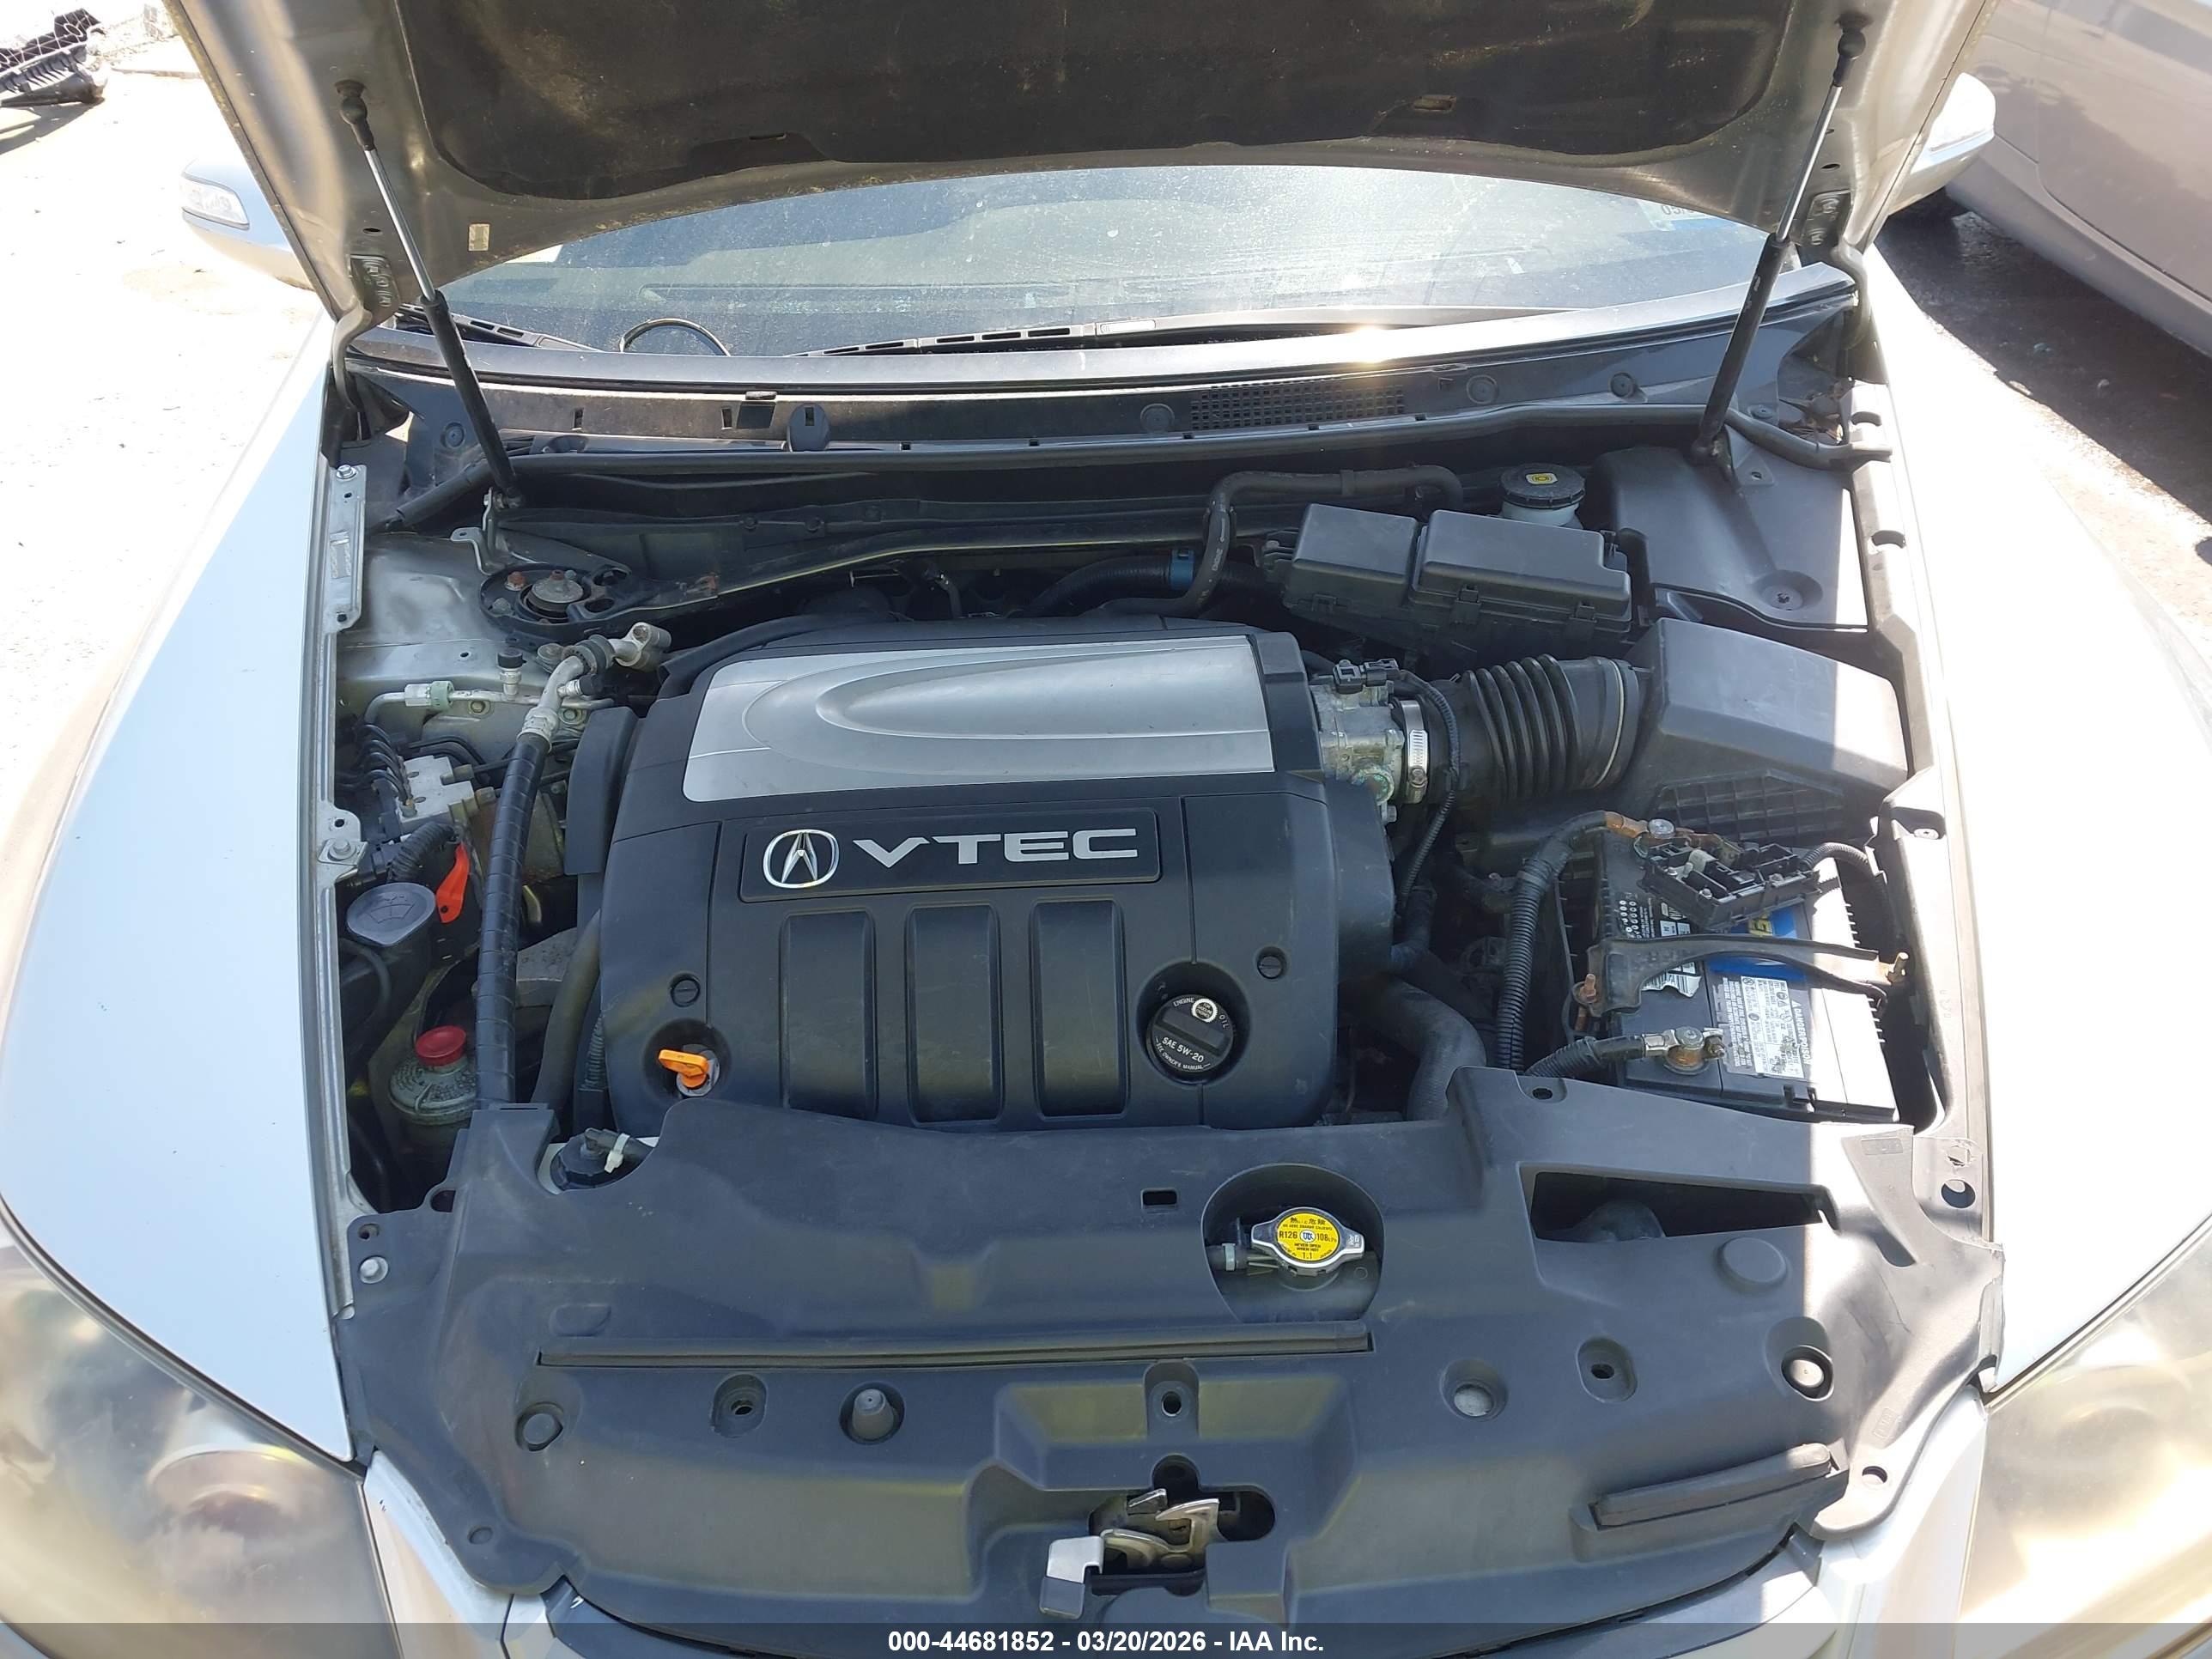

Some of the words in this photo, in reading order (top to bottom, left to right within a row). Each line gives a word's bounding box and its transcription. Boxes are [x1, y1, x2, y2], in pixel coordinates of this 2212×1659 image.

[852, 828, 1138, 868] VTEC
[1173, 997, 1195, 1007] ENGINE
[1219, 1014, 1230, 1029] OIL
[1162, 1036, 1177, 1049] SAE
[1176, 1044, 1204, 1063] 5W-20
[1279, 1231, 1297, 1239] R126
